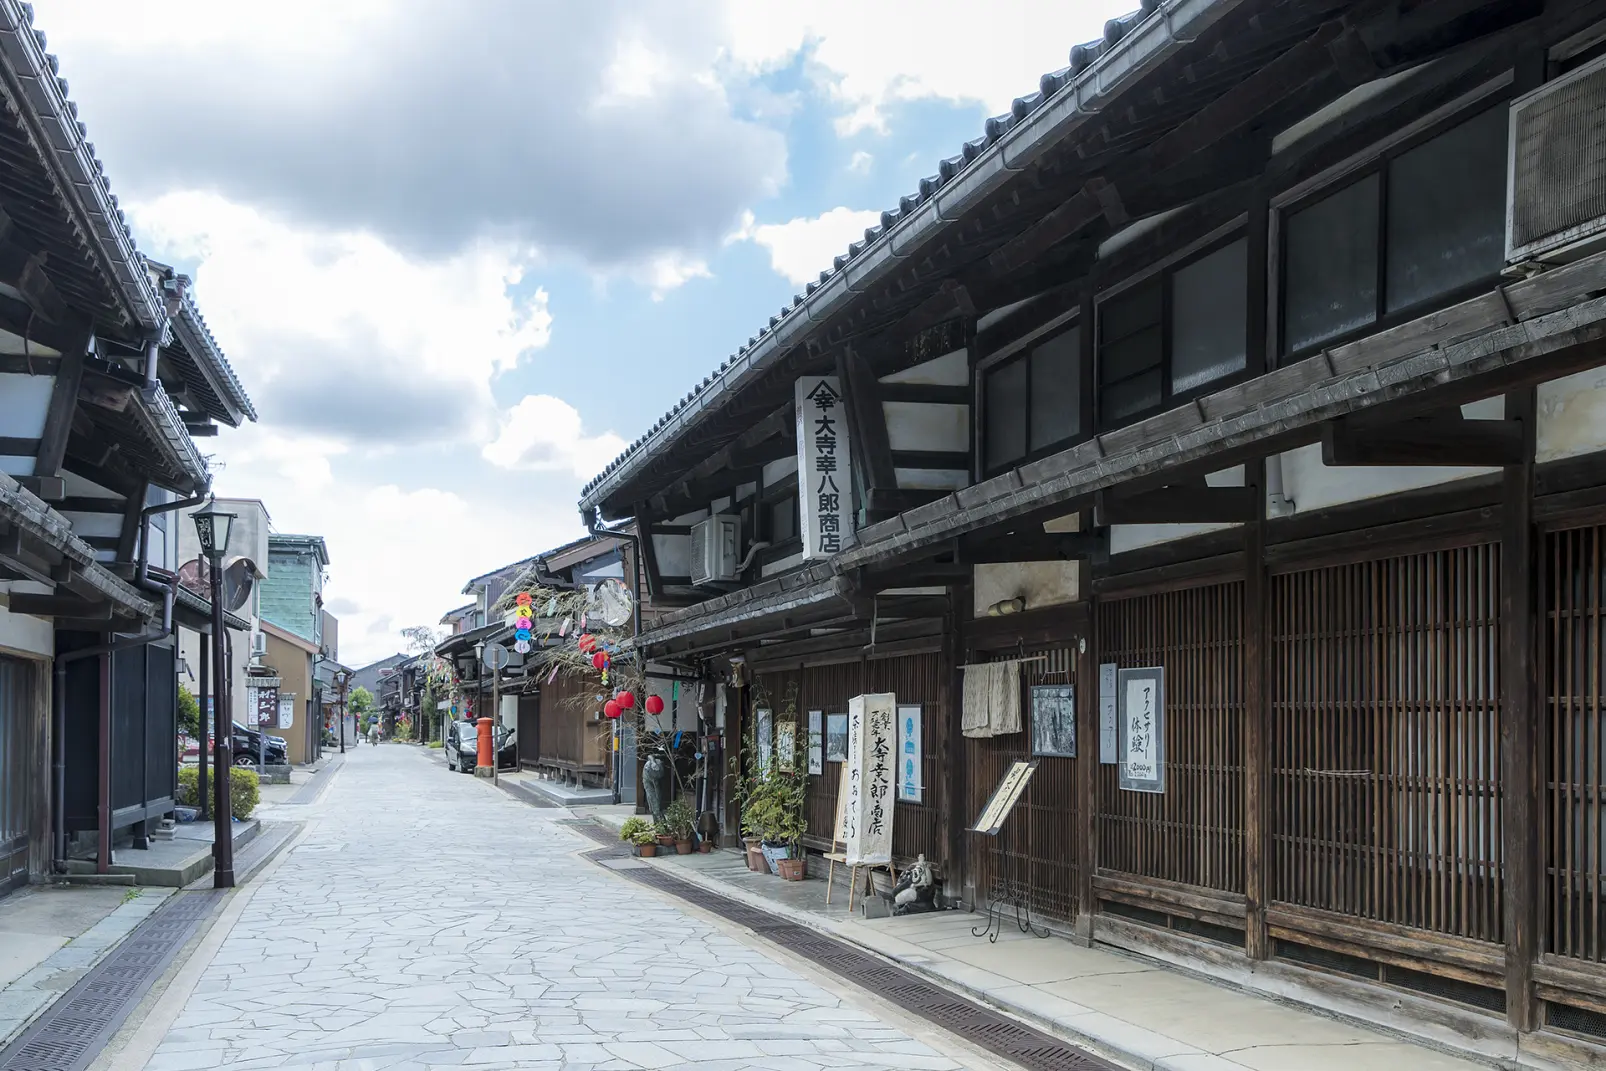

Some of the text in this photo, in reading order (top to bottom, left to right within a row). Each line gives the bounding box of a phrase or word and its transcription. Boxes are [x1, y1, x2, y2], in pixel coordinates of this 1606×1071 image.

[815, 415, 840, 553] 大寺幸八郎商店
[1130, 716, 1144, 752] 体験
[1142, 686, 1152, 759] アクセサリー
[868, 737, 889, 836] 大寺幸八郎商店
